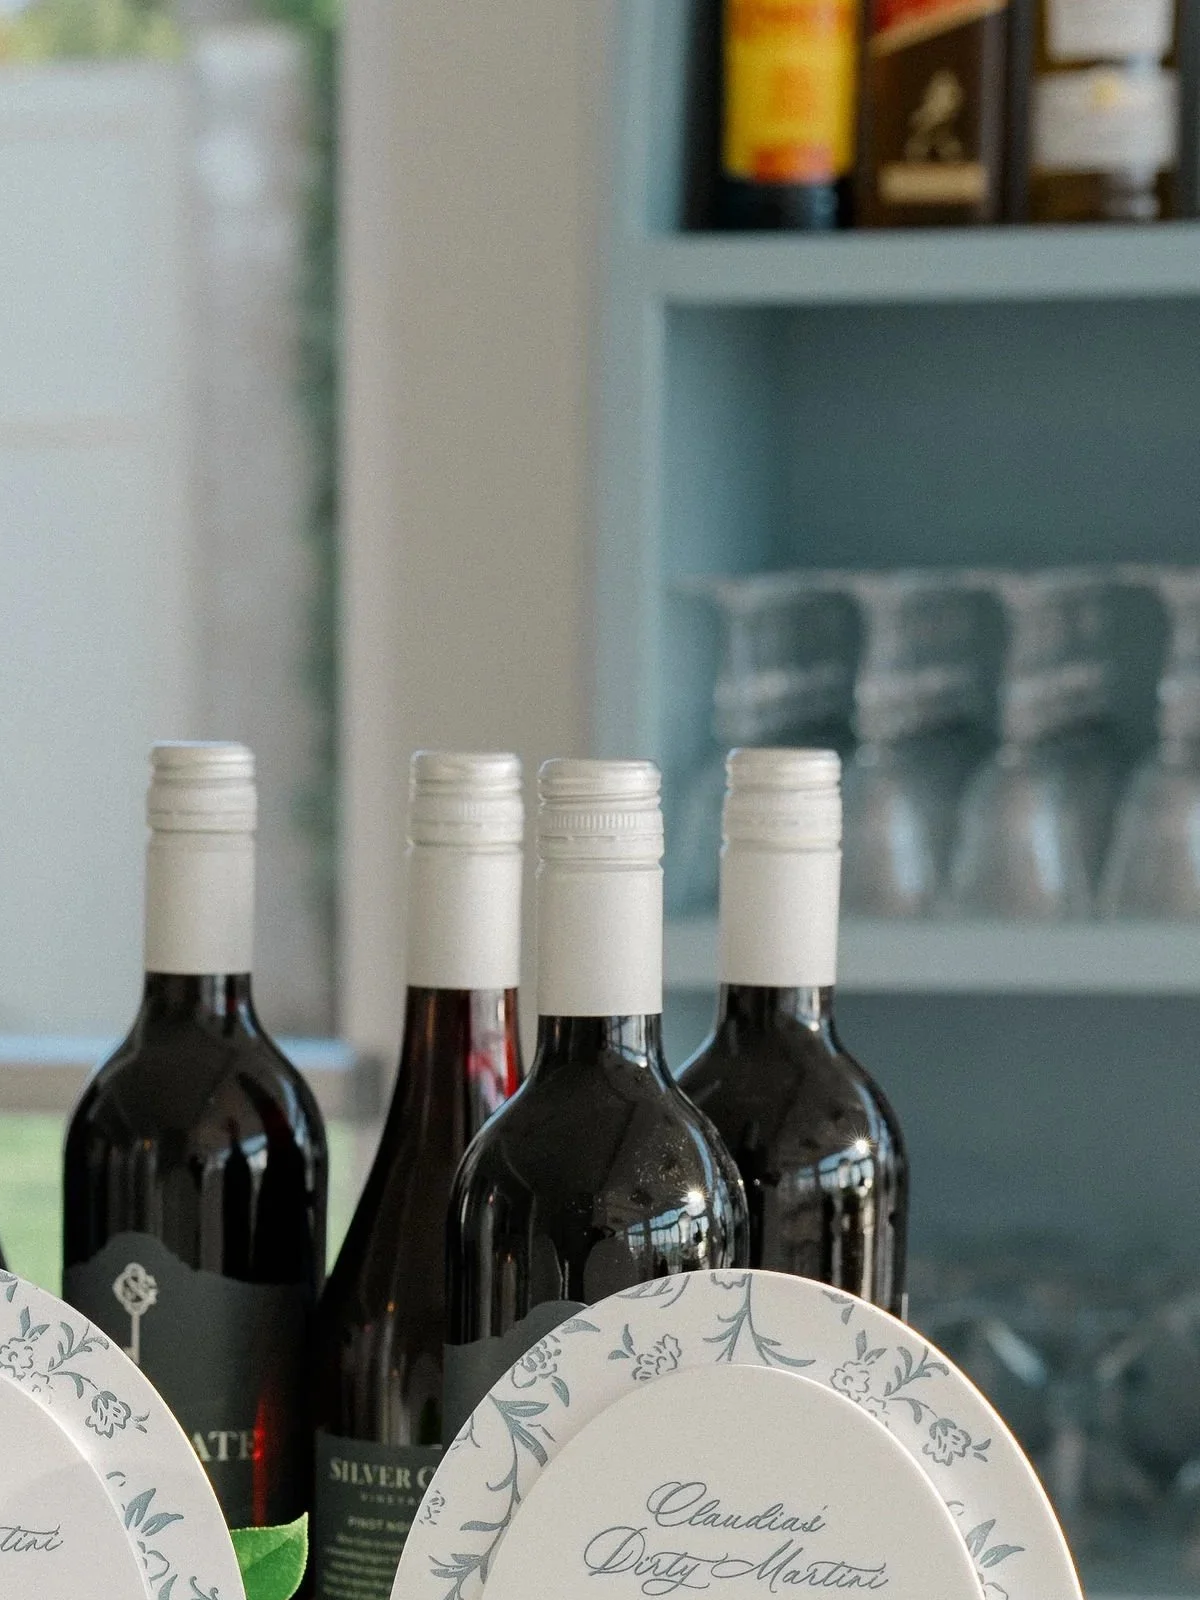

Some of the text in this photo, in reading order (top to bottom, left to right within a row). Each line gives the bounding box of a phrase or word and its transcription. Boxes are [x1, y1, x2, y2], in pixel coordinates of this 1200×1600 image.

[329, 1457, 412, 1490] SILVER
[583, 1526, 890, 1597] Dirty Martini
